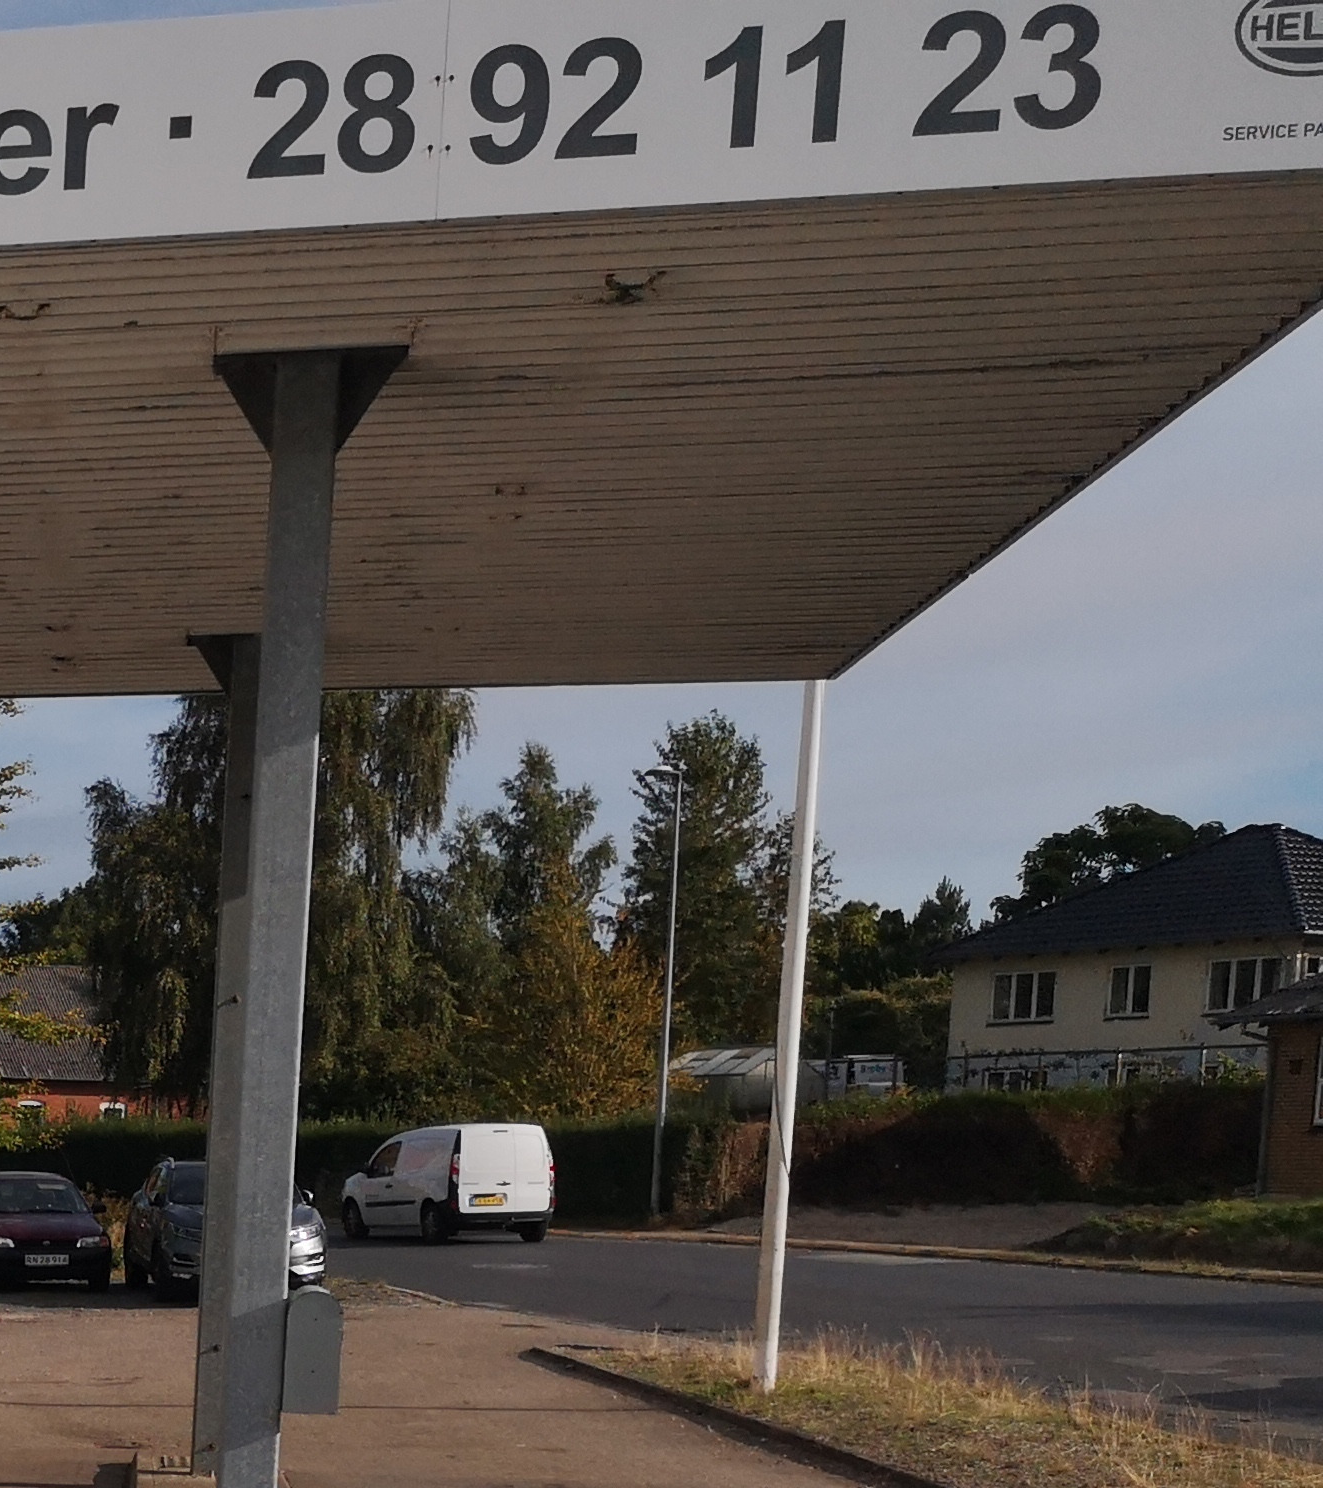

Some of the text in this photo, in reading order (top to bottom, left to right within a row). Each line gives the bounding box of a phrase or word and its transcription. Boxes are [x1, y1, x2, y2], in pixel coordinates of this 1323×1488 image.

[246, 53, 416, 180] 28
[469, 36, 642, 165] 92
[702, 19, 847, 149] 11
[912, 3, 1102, 137] 23
[1222, 123, 1299, 141] SERVICE
